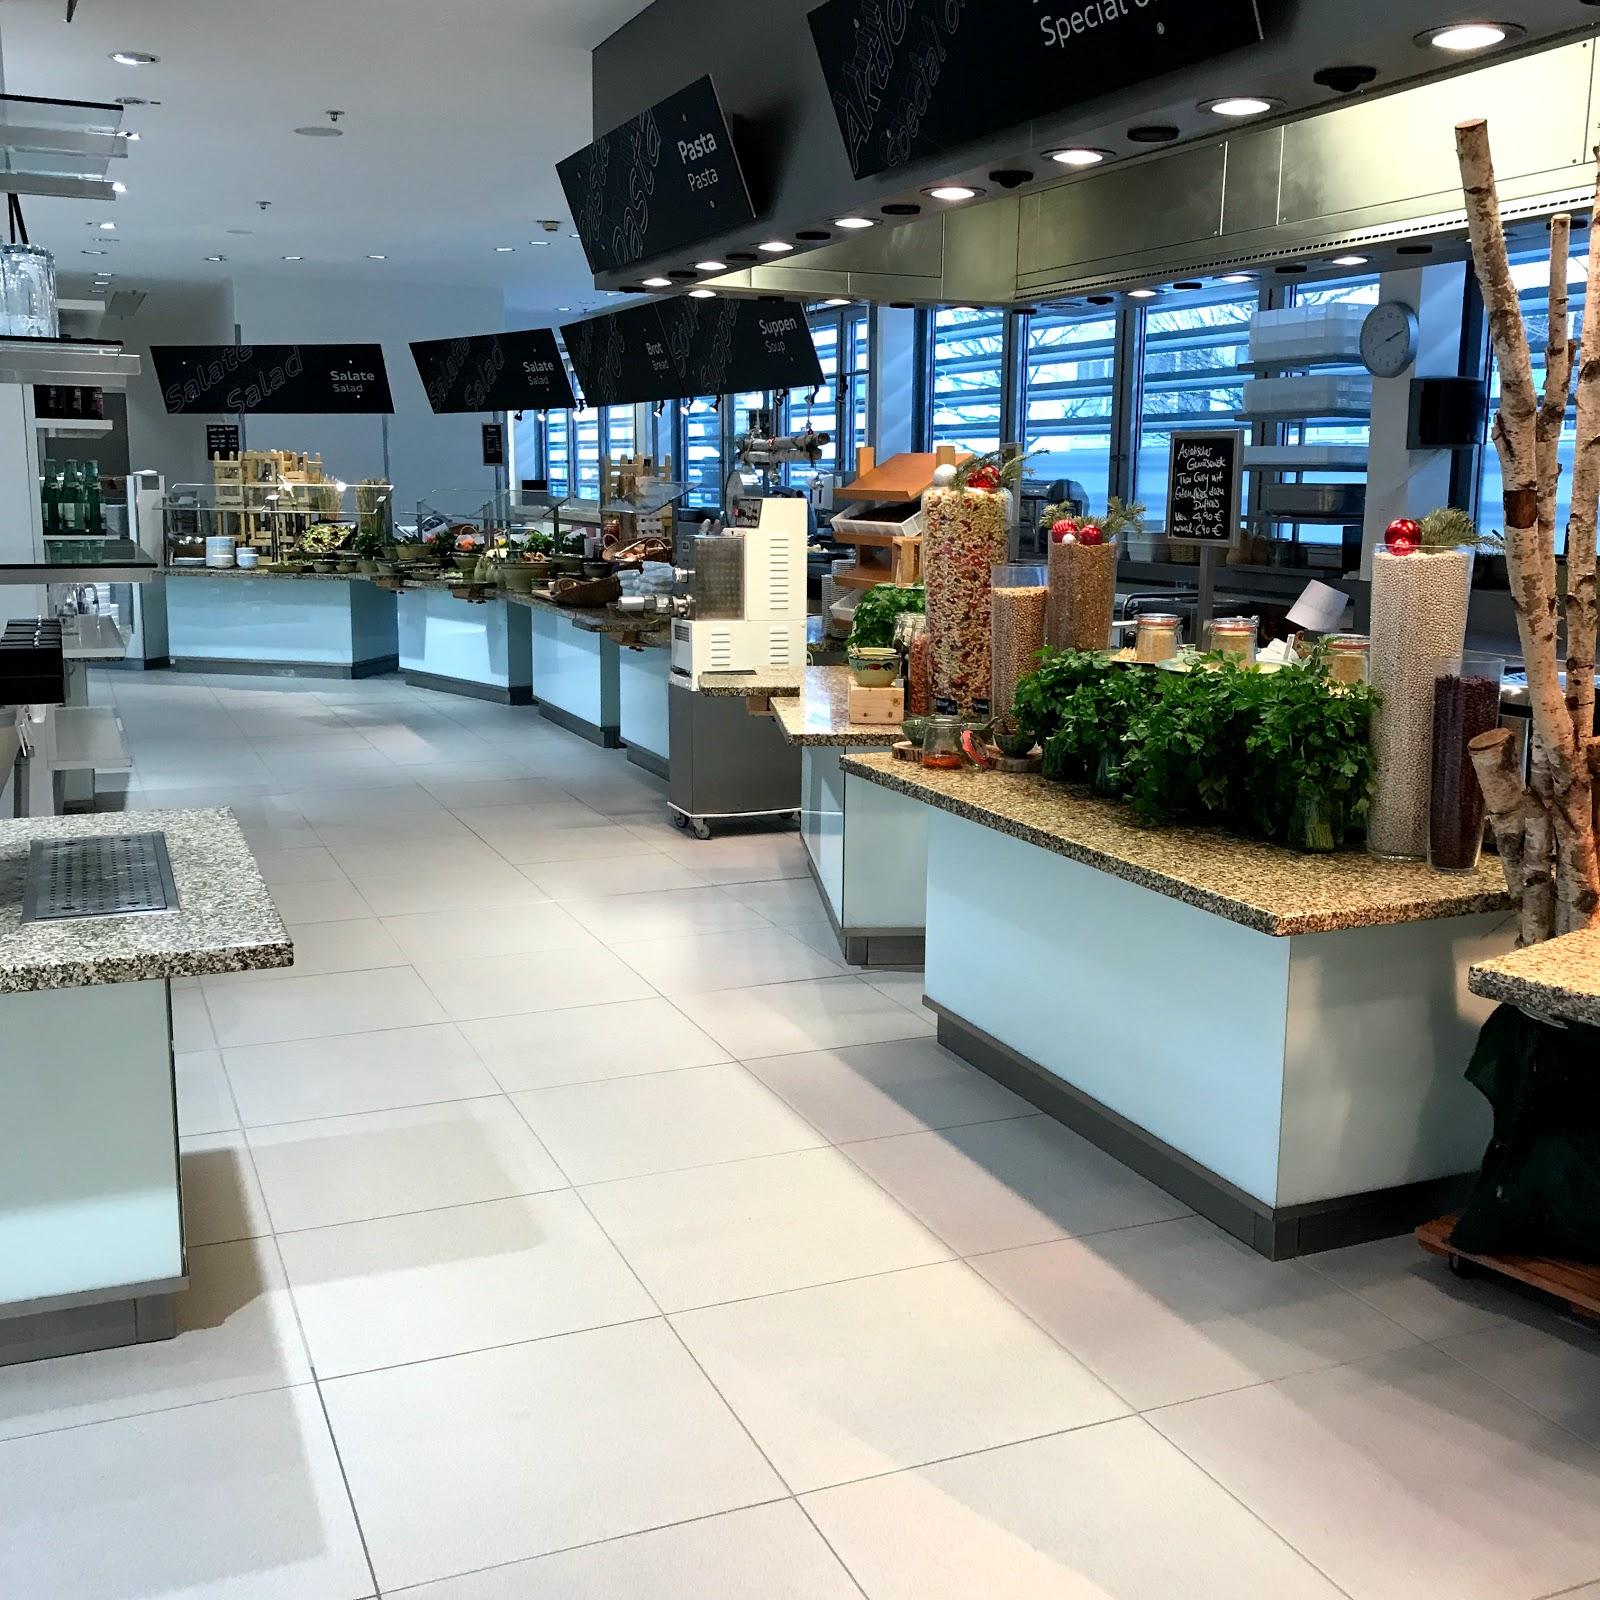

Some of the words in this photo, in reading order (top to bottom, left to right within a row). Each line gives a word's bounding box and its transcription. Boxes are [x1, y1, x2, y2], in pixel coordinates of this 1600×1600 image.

[677, 132, 718, 165] Pasta
[687, 167, 719, 192] Pasta
[758, 315, 798, 338] Suppen
[646, 341, 664, 356] Brot
[765, 339, 786, 354] Soup
[523, 361, 554, 373] Salate
[166, 344, 253, 414] Salate
[226, 346, 304, 414] Salad
[330, 370, 375, 381] Salate
[527, 375, 550, 386] Salad
[333, 383, 363, 393] Salad
[1213, 510, 1225, 522] €
[1211, 523, 1224, 537] €
